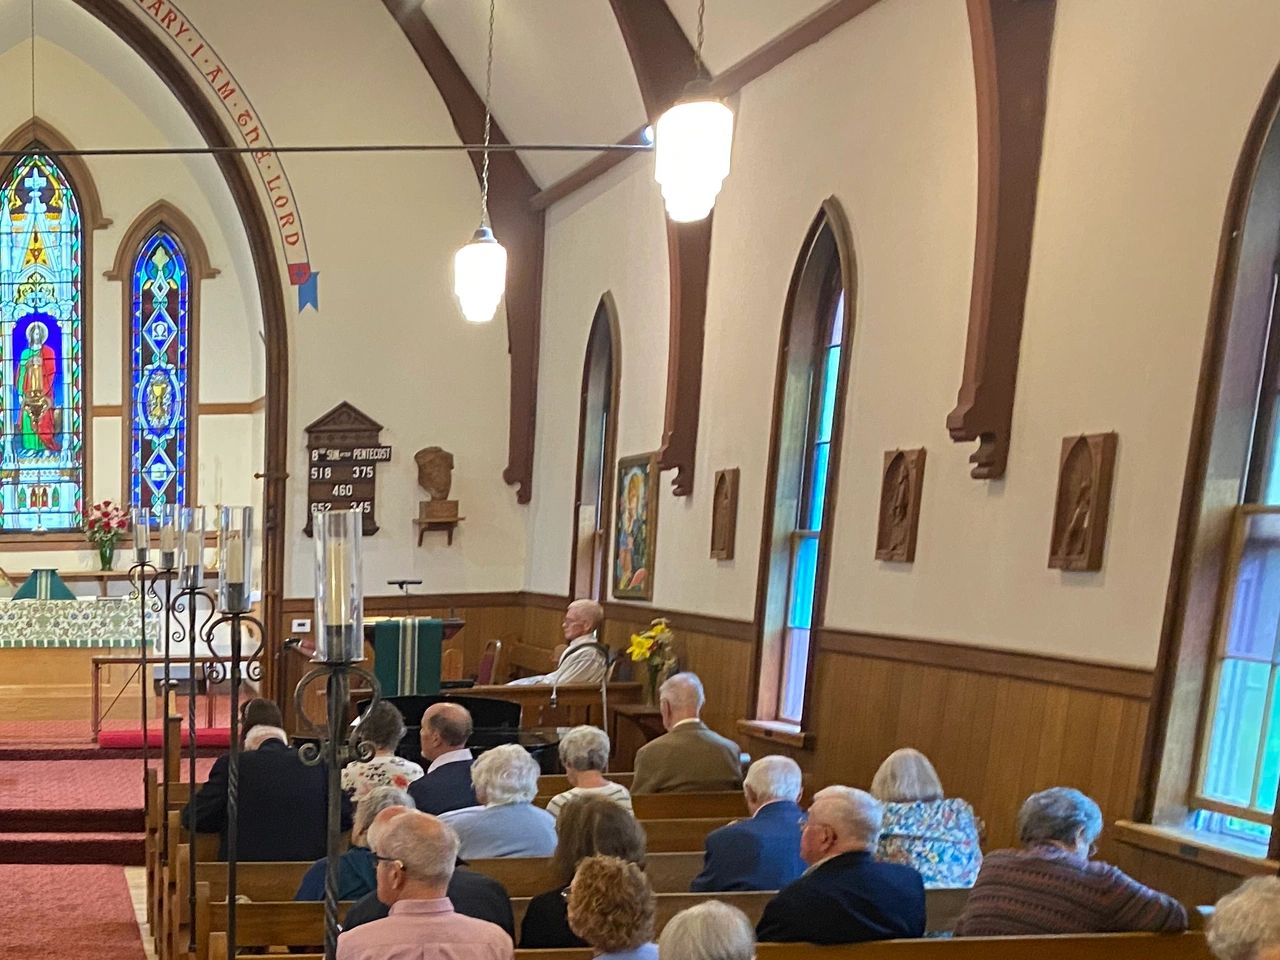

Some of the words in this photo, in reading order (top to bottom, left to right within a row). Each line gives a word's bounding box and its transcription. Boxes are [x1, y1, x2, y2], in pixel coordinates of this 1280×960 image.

[140, 0, 190, 38] ARY
[191, 43, 204, 58] I
[206, 64, 236, 100] AM
[266, 174, 300, 246] LORD
[352, 448, 391, 460] PENTECOST
[310, 467, 332, 479] 518
[352, 466, 374, 478] 375
[332, 484, 353, 496] 460
